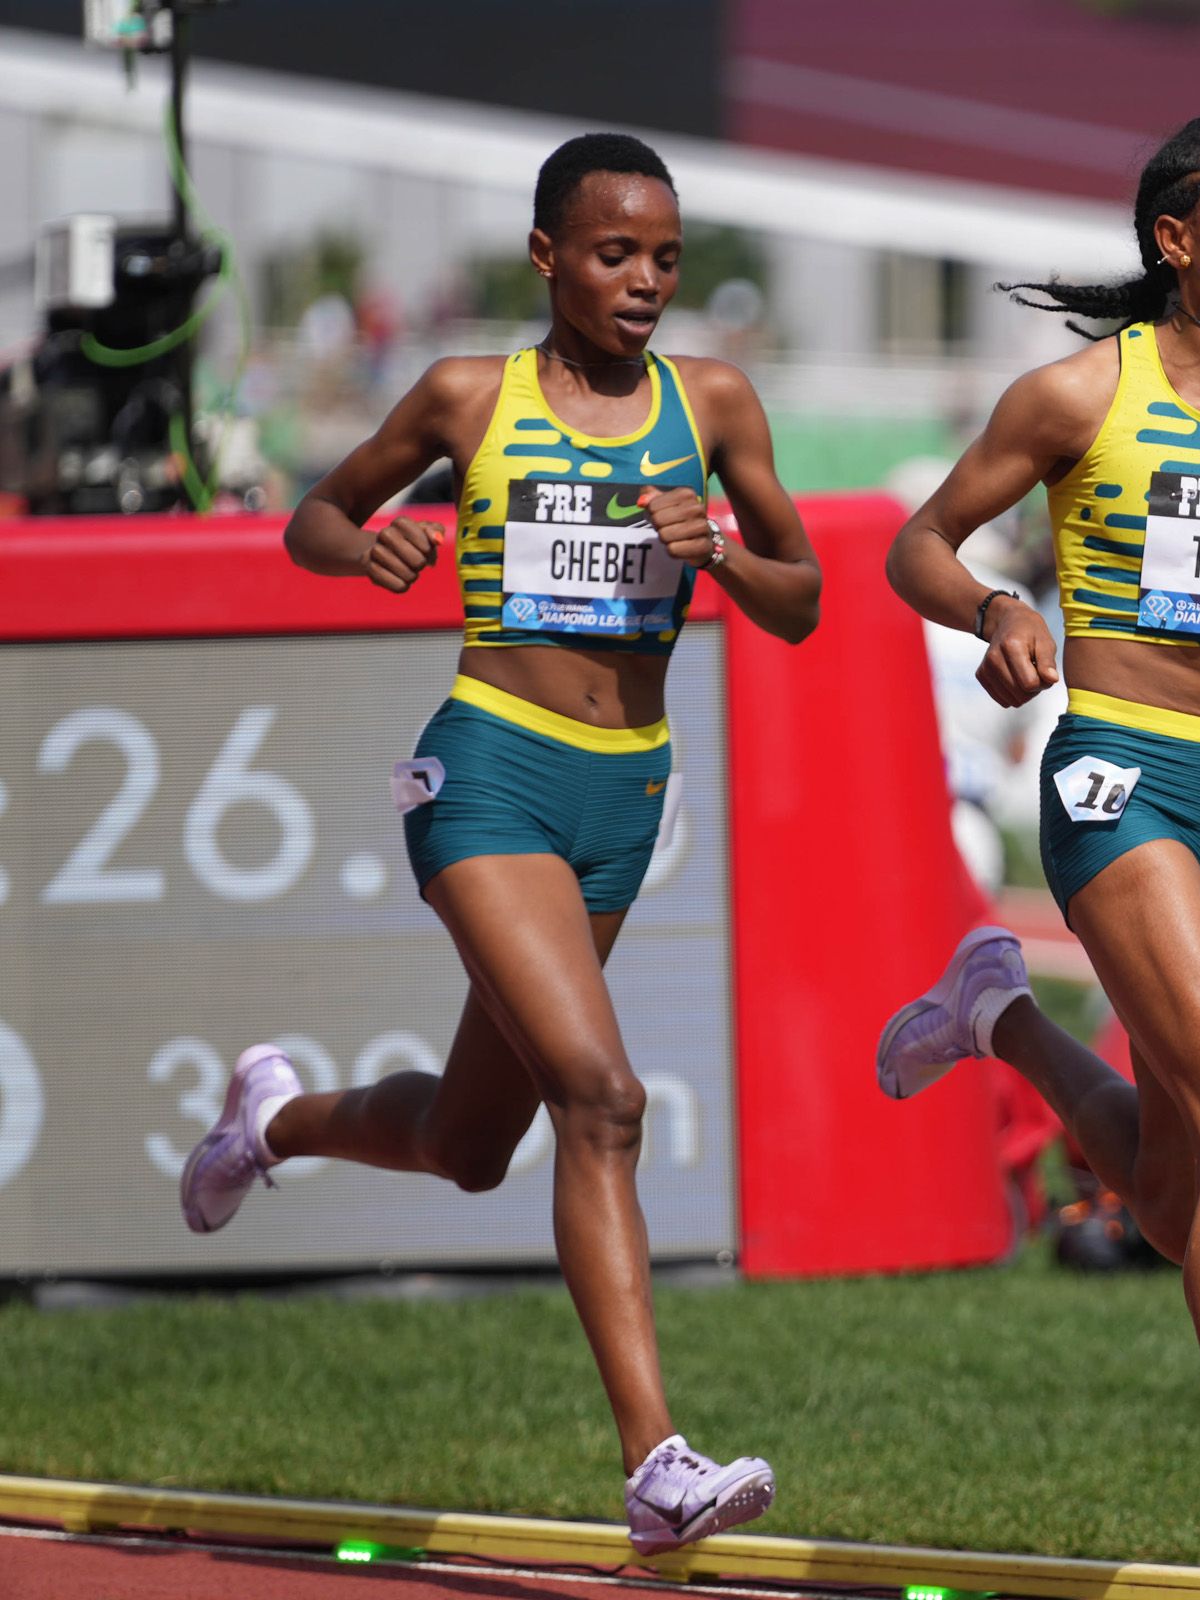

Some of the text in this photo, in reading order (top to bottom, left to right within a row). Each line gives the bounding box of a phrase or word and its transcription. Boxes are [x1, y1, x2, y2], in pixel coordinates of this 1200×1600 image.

[535, 483, 593, 524] PRE
[551, 539, 652, 585] CHEBET
[1075, 771, 1126, 814] 10
